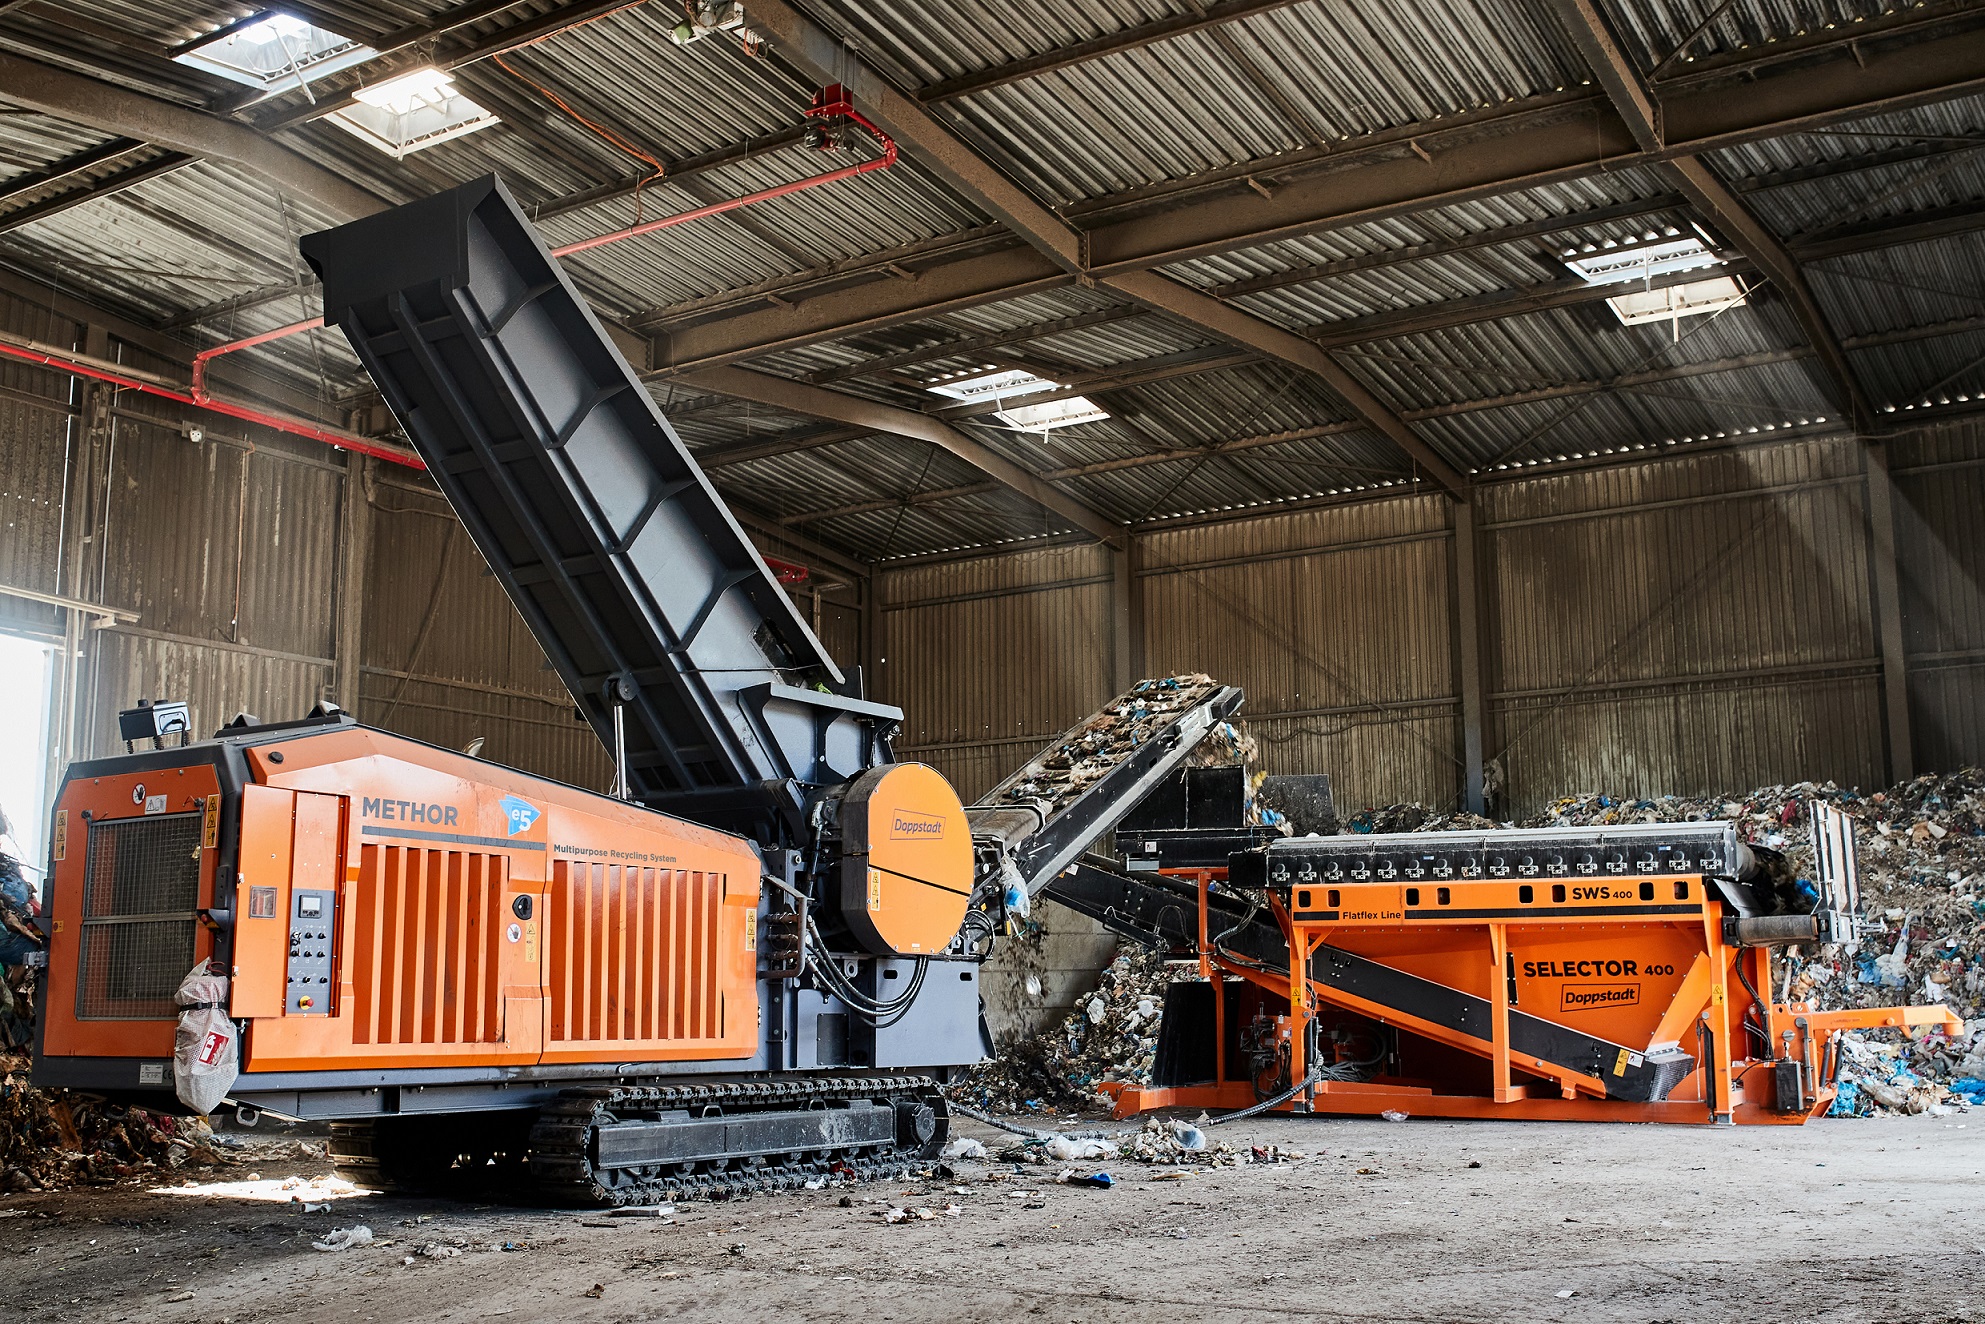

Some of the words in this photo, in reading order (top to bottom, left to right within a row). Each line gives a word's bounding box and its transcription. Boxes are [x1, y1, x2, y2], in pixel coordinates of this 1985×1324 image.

[362, 796, 458, 826] METHOR
[511, 808, 532, 832] e5
[894, 818, 942, 836] Doppstadt
[553, 844, 608, 857] Multipurpose
[610, 850, 648, 861] Recycling
[650, 853, 677, 863] System
[1572, 886, 1610, 900] SWS
[1612, 890, 1633, 899] 400
[1342, 911, 1378, 919] Flatflex
[1381, 910, 1401, 919] Line
[1523, 960, 1639, 977] SELECTOR
[1644, 964, 1675, 976] 400
[1565, 988, 1635, 1005] Doppstadt
